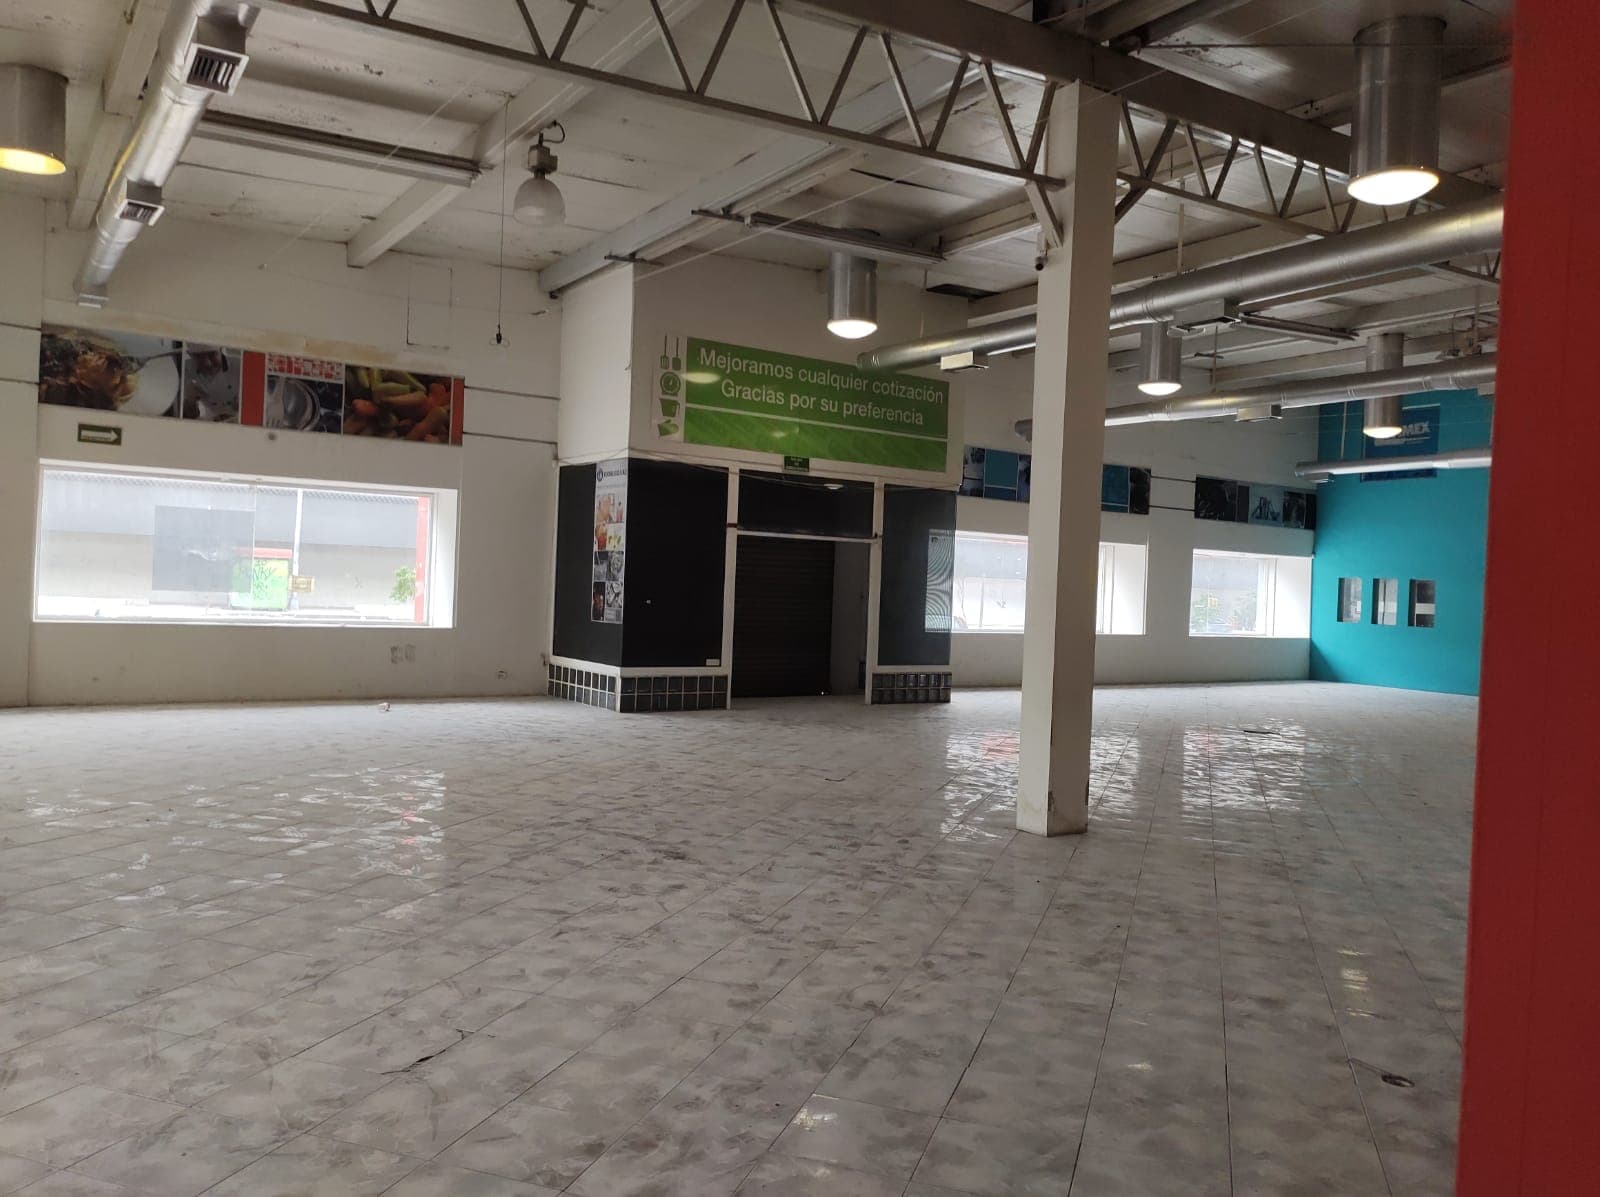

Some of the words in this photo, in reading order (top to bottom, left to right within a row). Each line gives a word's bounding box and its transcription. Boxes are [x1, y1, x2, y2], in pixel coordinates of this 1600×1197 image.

[700, 347, 794, 380] Mejoramos
[798, 368, 869, 392] cualquier
[872, 380, 943, 404] cotización
[721, 378, 785, 405] Gracias
[790, 393, 817, 411] por
[820, 397, 838, 413] su
[843, 401, 924, 425] preferencia
